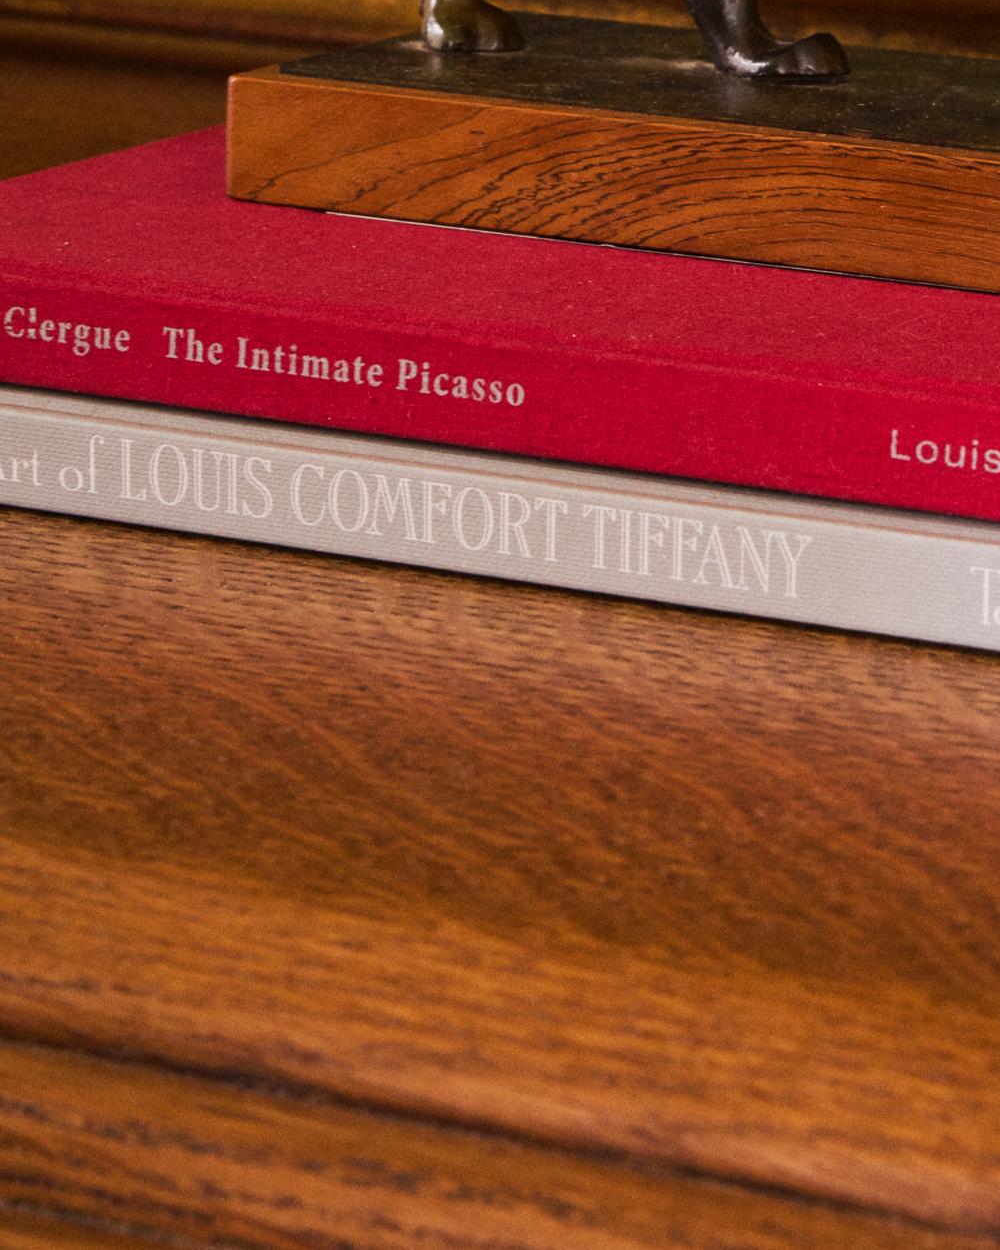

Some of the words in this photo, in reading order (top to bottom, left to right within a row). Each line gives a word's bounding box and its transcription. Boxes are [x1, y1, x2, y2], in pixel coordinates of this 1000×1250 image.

[4, 307, 130, 356] Clergue
[163, 327, 224, 365] The
[236, 337, 385, 387] Intimate
[395, 359, 525, 407] Picasso
[0, 449, 40, 486] rt
[59, 435, 104, 494] of
[120, 439, 273, 519] LOUIS
[290, 464, 568, 562] COMFORT
[582, 504, 812, 598] TIFFANY
